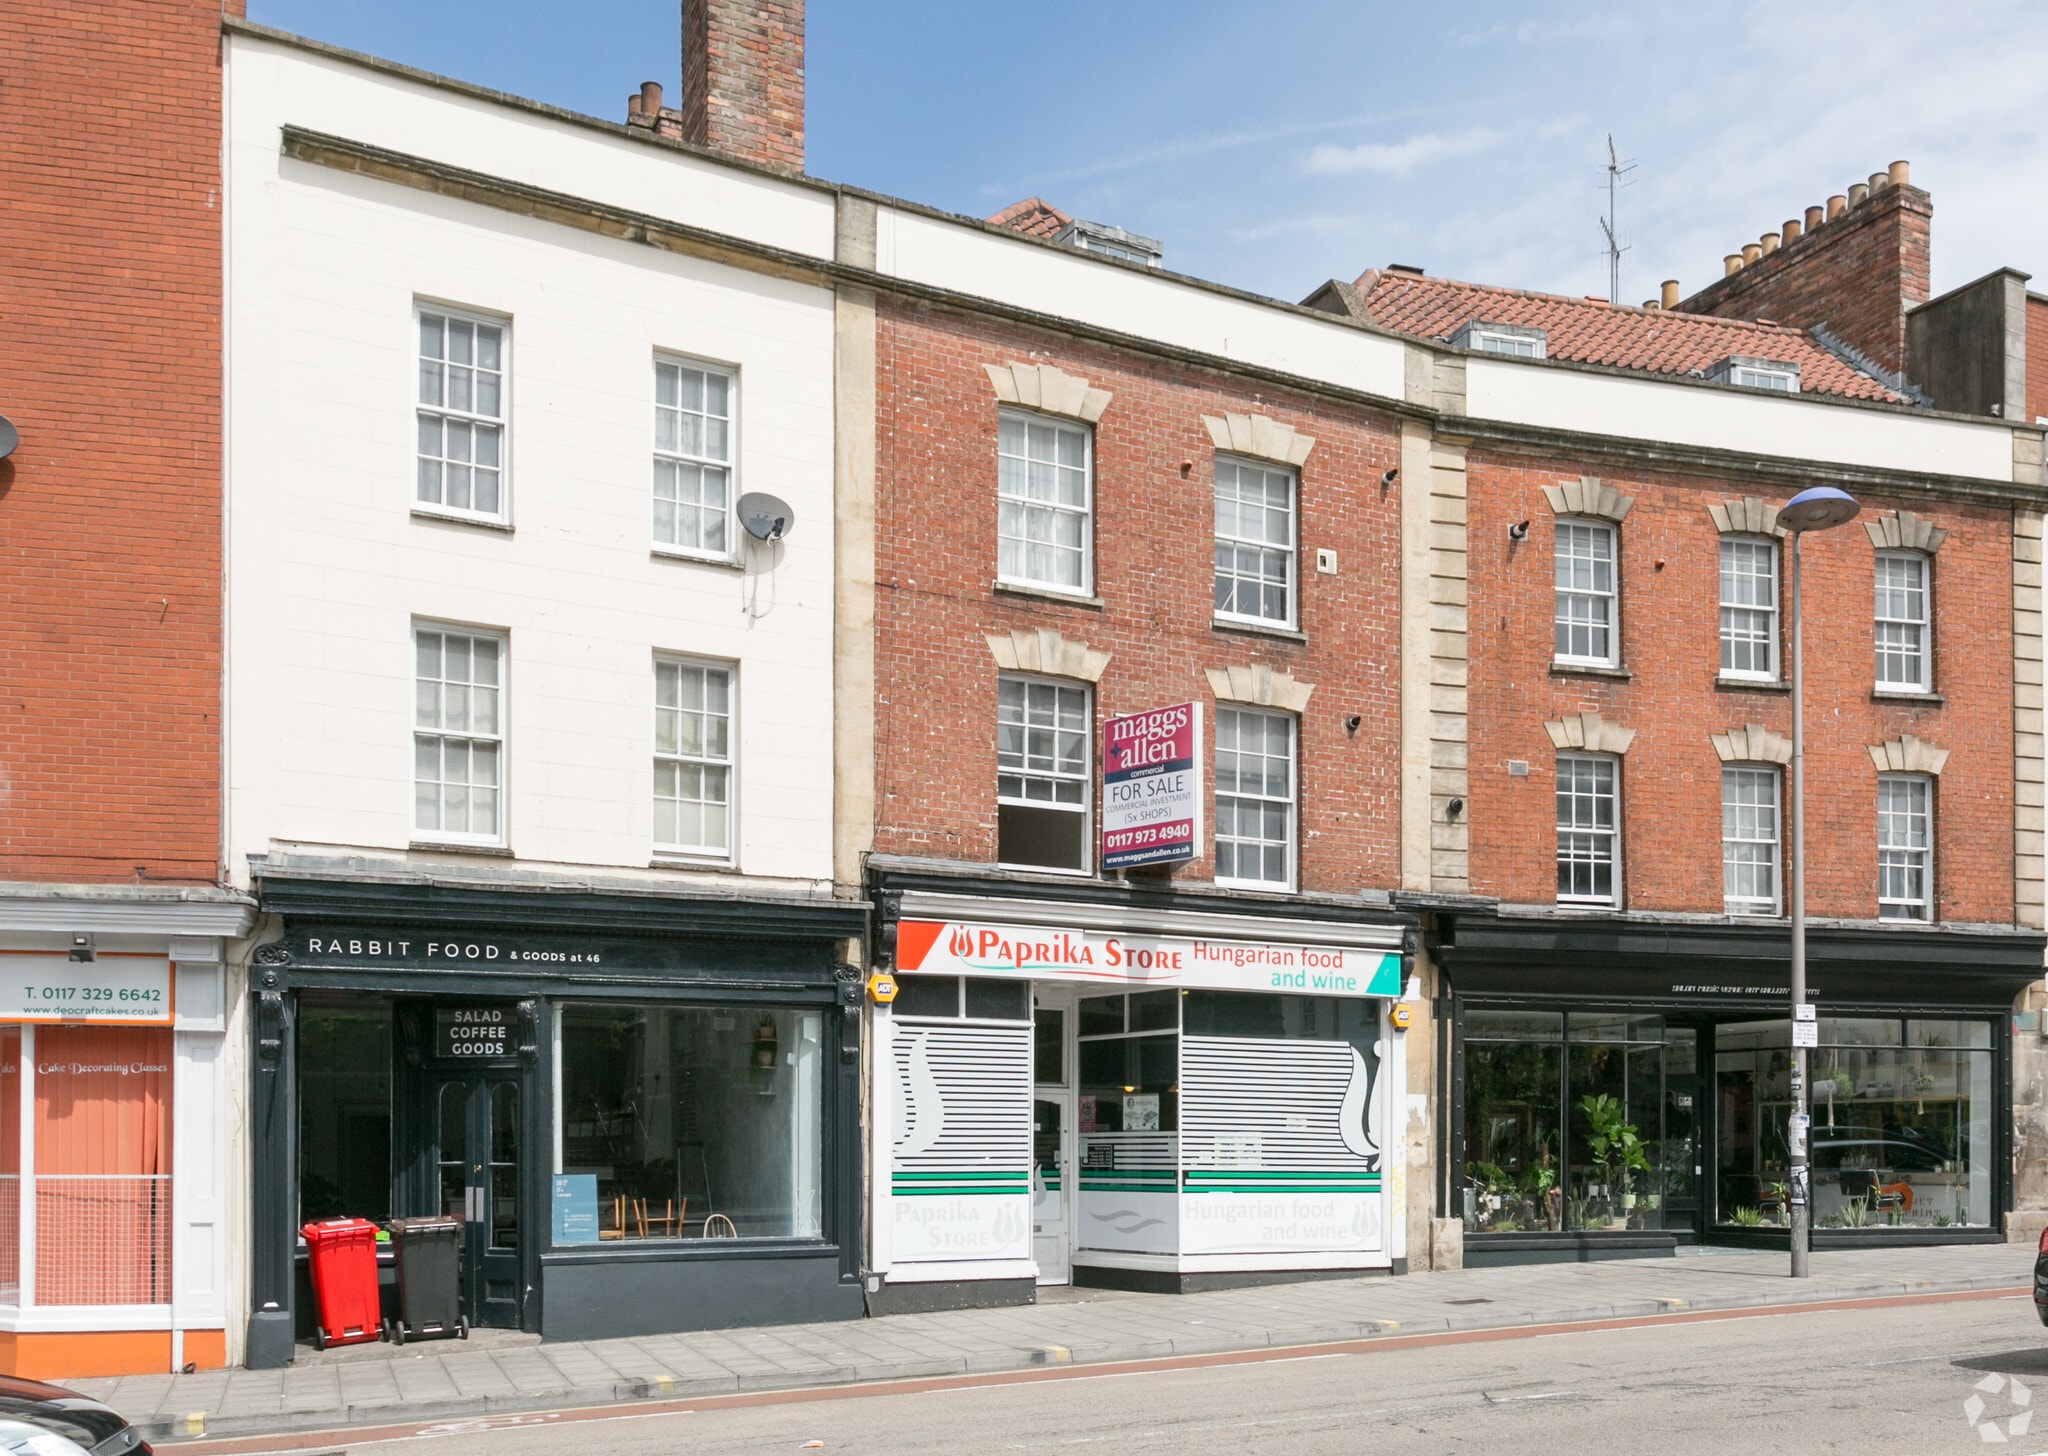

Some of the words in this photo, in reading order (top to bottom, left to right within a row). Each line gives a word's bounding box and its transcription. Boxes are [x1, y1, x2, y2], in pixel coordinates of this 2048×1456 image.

[1113, 706, 1188, 741] maggs
[1120, 738, 1177, 769] allen
[1130, 764, 1164, 778] commercial
[1112, 782, 1141, 803] FOR
[1147, 774, 1184, 797] SALE
[1105, 799, 1148, 814] COMMERCIAL
[1150, 792, 1192, 806] INVESTMENT
[1140, 806, 1172, 821] SHOPS)
[1107, 832, 1133, 848] 0117
[1135, 829, 1157, 844] 973
[1159, 823, 1190, 840] 4940
[1106, 845, 1190, 864] www.maggsandallen.co.uk
[309, 938, 410, 956] RABBIT
[428, 943, 499, 959] FOOD
[510, 951, 518, 960] &
[522, 951, 566, 962] GOODS
[570, 953, 582, 962] at
[586, 953, 600, 963] 46
[1193, 941, 1294, 968] Hungarian
[1300, 947, 1343, 969] food
[1270, 969, 1306, 988] and
[1312, 971, 1356, 991] wine
[25, 987, 37, 999] T.
[42, 987, 76, 1000] 0117
[82, 988, 113, 1000] 329
[119, 989, 161, 1001] 6642
[23, 1006, 160, 1016] www.deocraftcakes.co.uk
[454, 1011, 502, 1022] SALAD
[450, 1026, 506, 1039] COFFEE
[452, 1042, 504, 1055] GOODS
[38, 1062, 65, 1075] Cake
[69, 1063, 129, 1076] Decorating
[130, 1062, 168, 1074] Classes
[1186, 1200, 1285, 1222] Hungarian
[1292, 1199, 1334, 1218] food
[1262, 1223, 1297, 1240] and
[1303, 1221, 1347, 1240] wine
